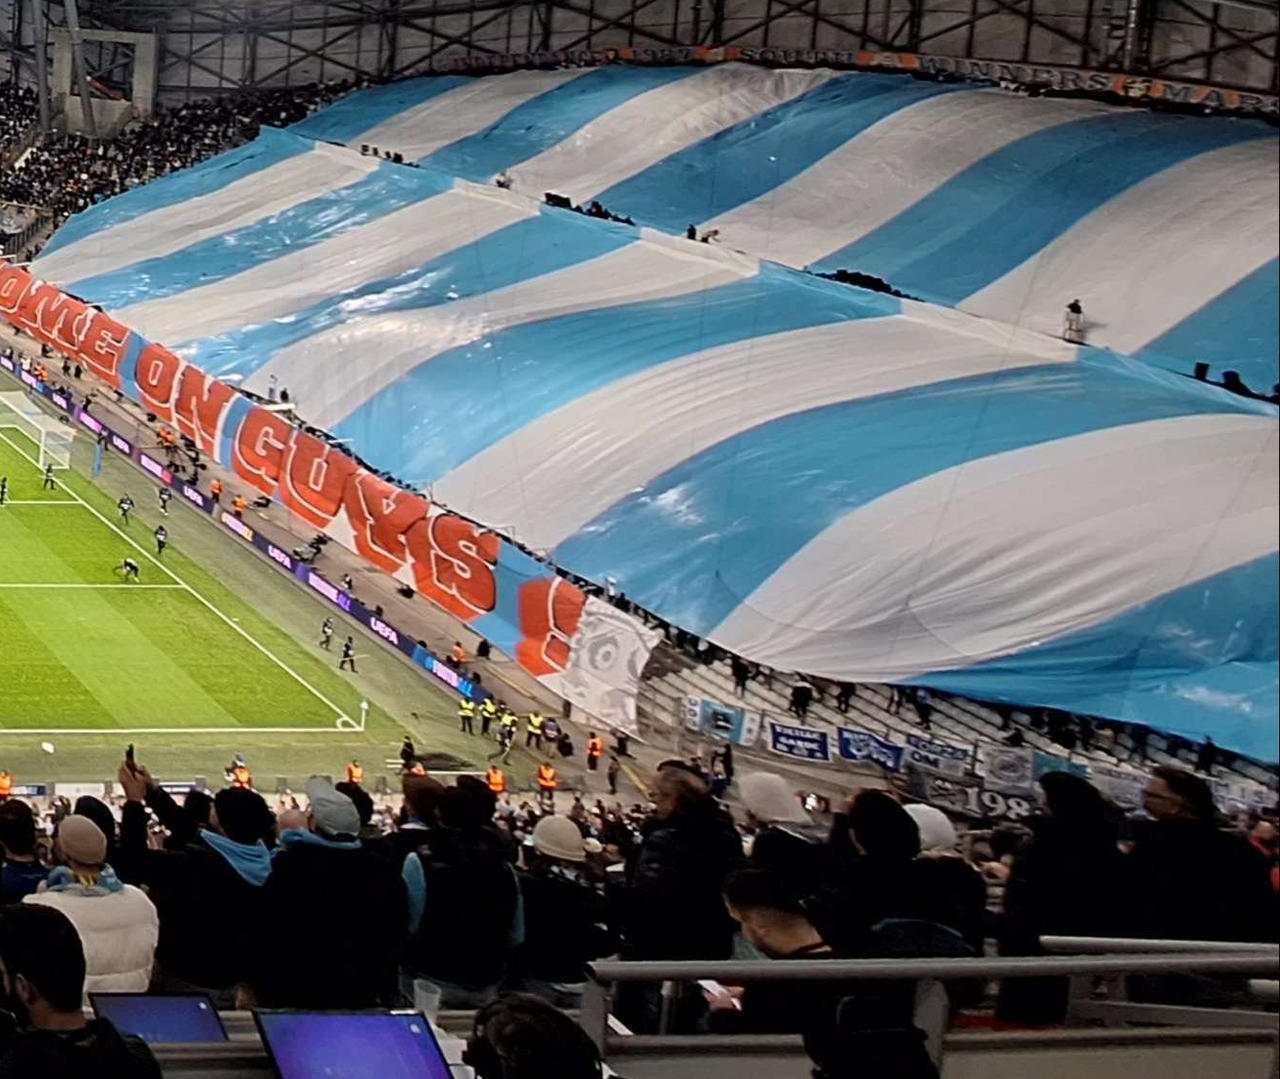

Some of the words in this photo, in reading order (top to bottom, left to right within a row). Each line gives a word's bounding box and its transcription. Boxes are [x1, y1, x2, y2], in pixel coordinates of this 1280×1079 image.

[135, 342, 240, 462] ON
[232, 405, 501, 619] GUYS
[370, 617, 399, 645] UEFA
